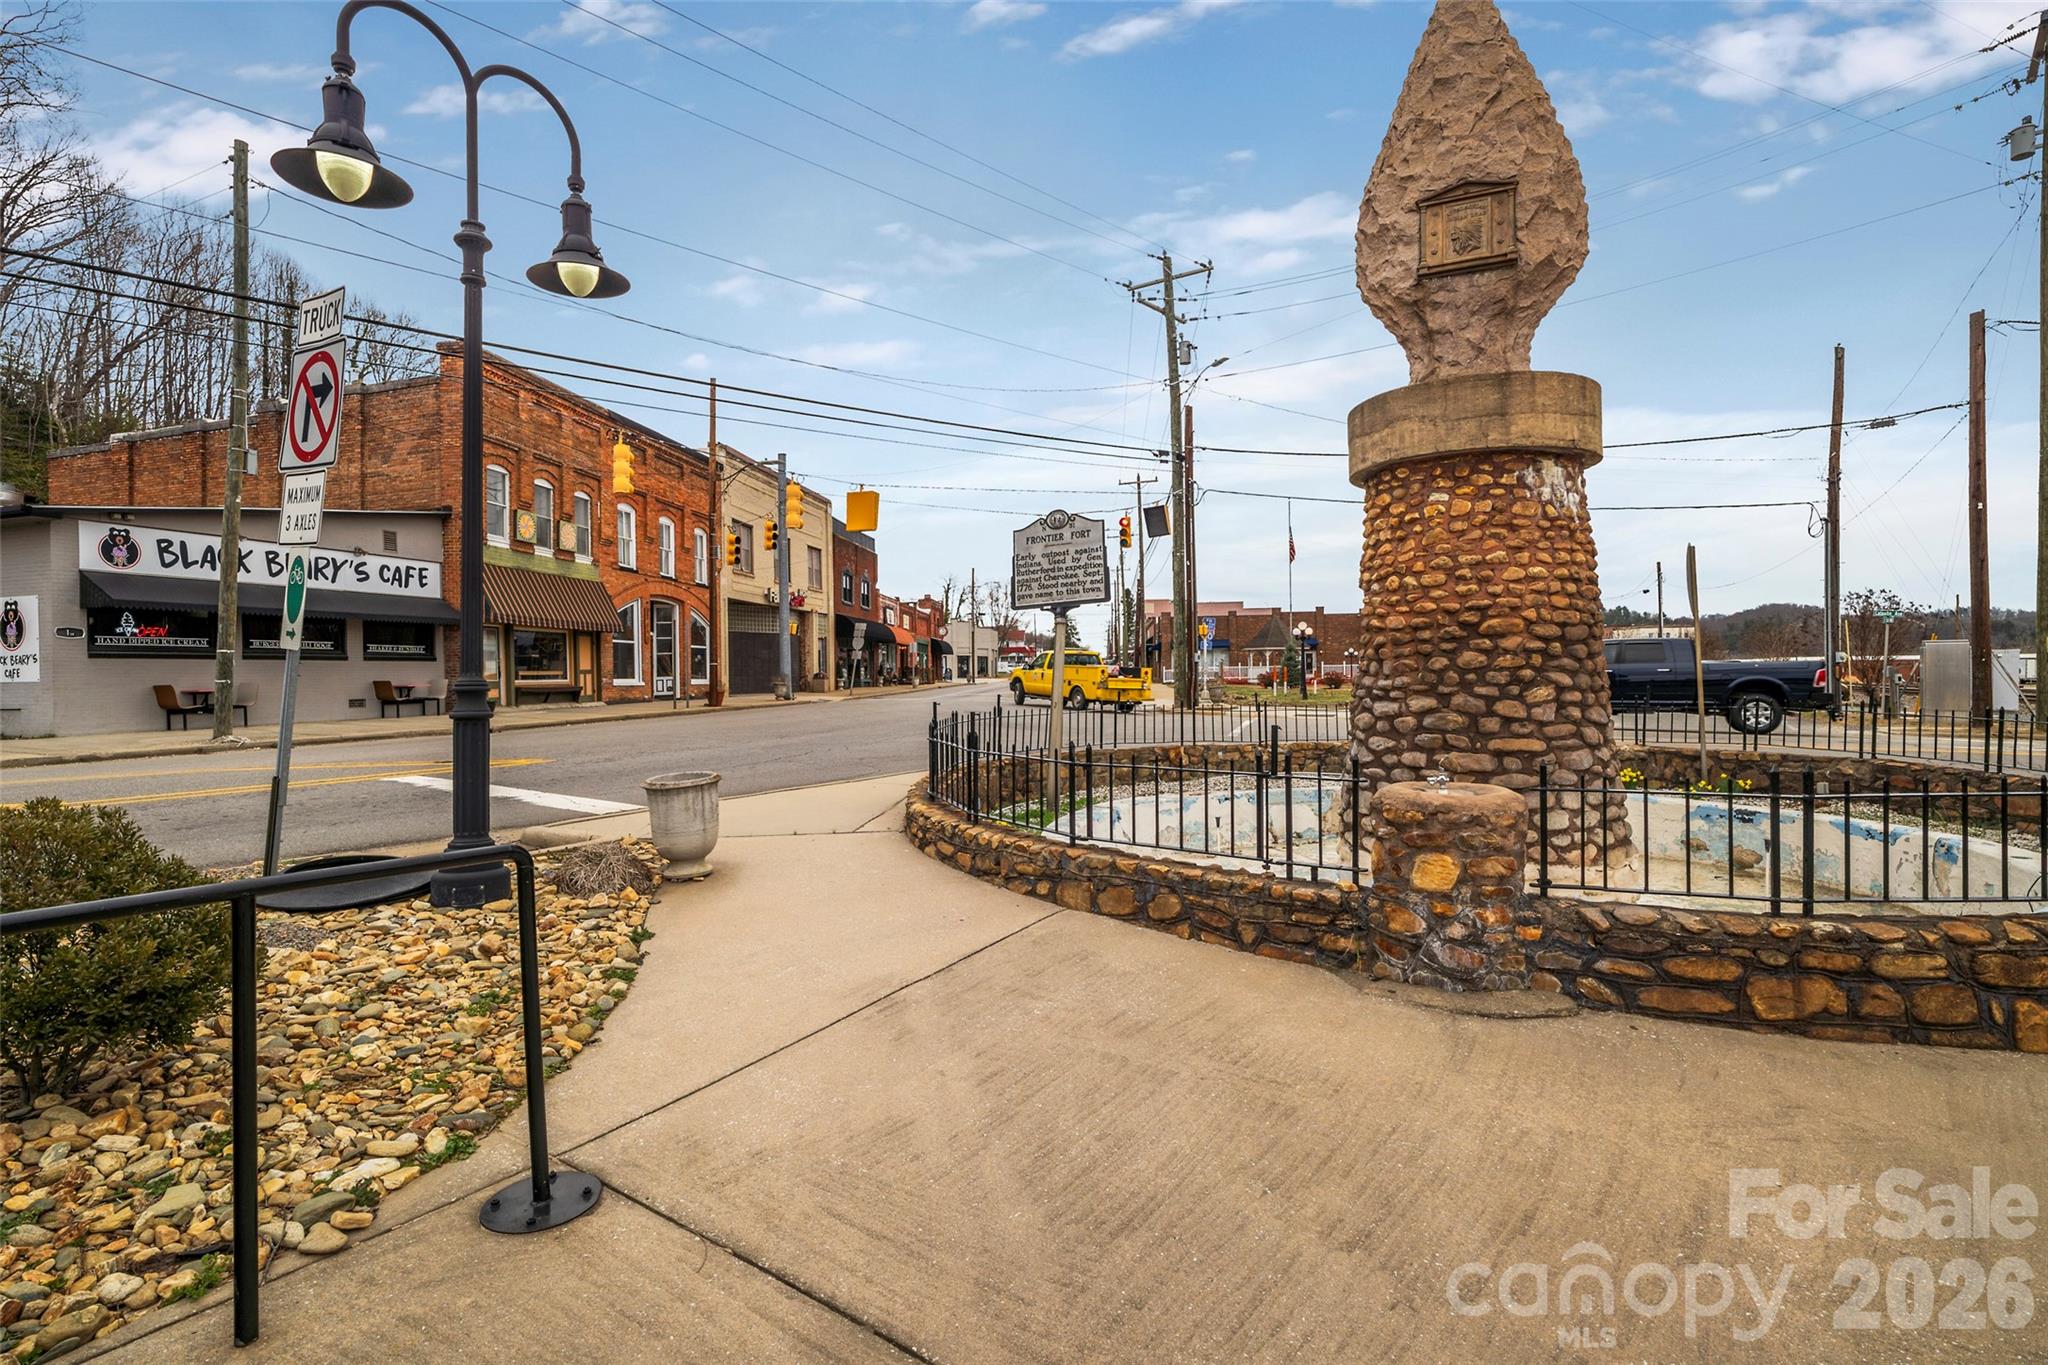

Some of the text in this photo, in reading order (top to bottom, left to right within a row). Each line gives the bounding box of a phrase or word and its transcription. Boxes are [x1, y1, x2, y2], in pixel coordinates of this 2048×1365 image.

[303, 300, 341, 335] TRUCK
[286, 484, 322, 505] MAXIMUM
[285, 513, 317, 532] 3 AXLES
[1026, 530, 1091, 545] FRONTIER FORT
[1016, 545, 1102, 562] Early outpost against
[1048, 557, 1066, 565] Used
[1071, 556, 1082, 564] by
[156, 538, 430, 589] BLAK BRY'S CAFE
[1016, 567, 1056, 577] Rutherford
[1065, 562, 1103, 573] expedition
[1017, 575, 1042, 584] against
[1037, 582, 1058, 590] Stood
[1060, 579, 1087, 588] nearby
[1017, 592, 1033, 601] gave
[1035, 590, 1053, 598] name
[1066, 587, 1080, 595] this
[137, 625, 167, 637] OPEN
[97, 637, 125, 645] HAND
[129, 638, 160, 646] DIPPED
[177, 639, 208, 647] CREAM
[10, 653, 38, 666] BEARY'S
[4, 668, 20, 679] CAFE
